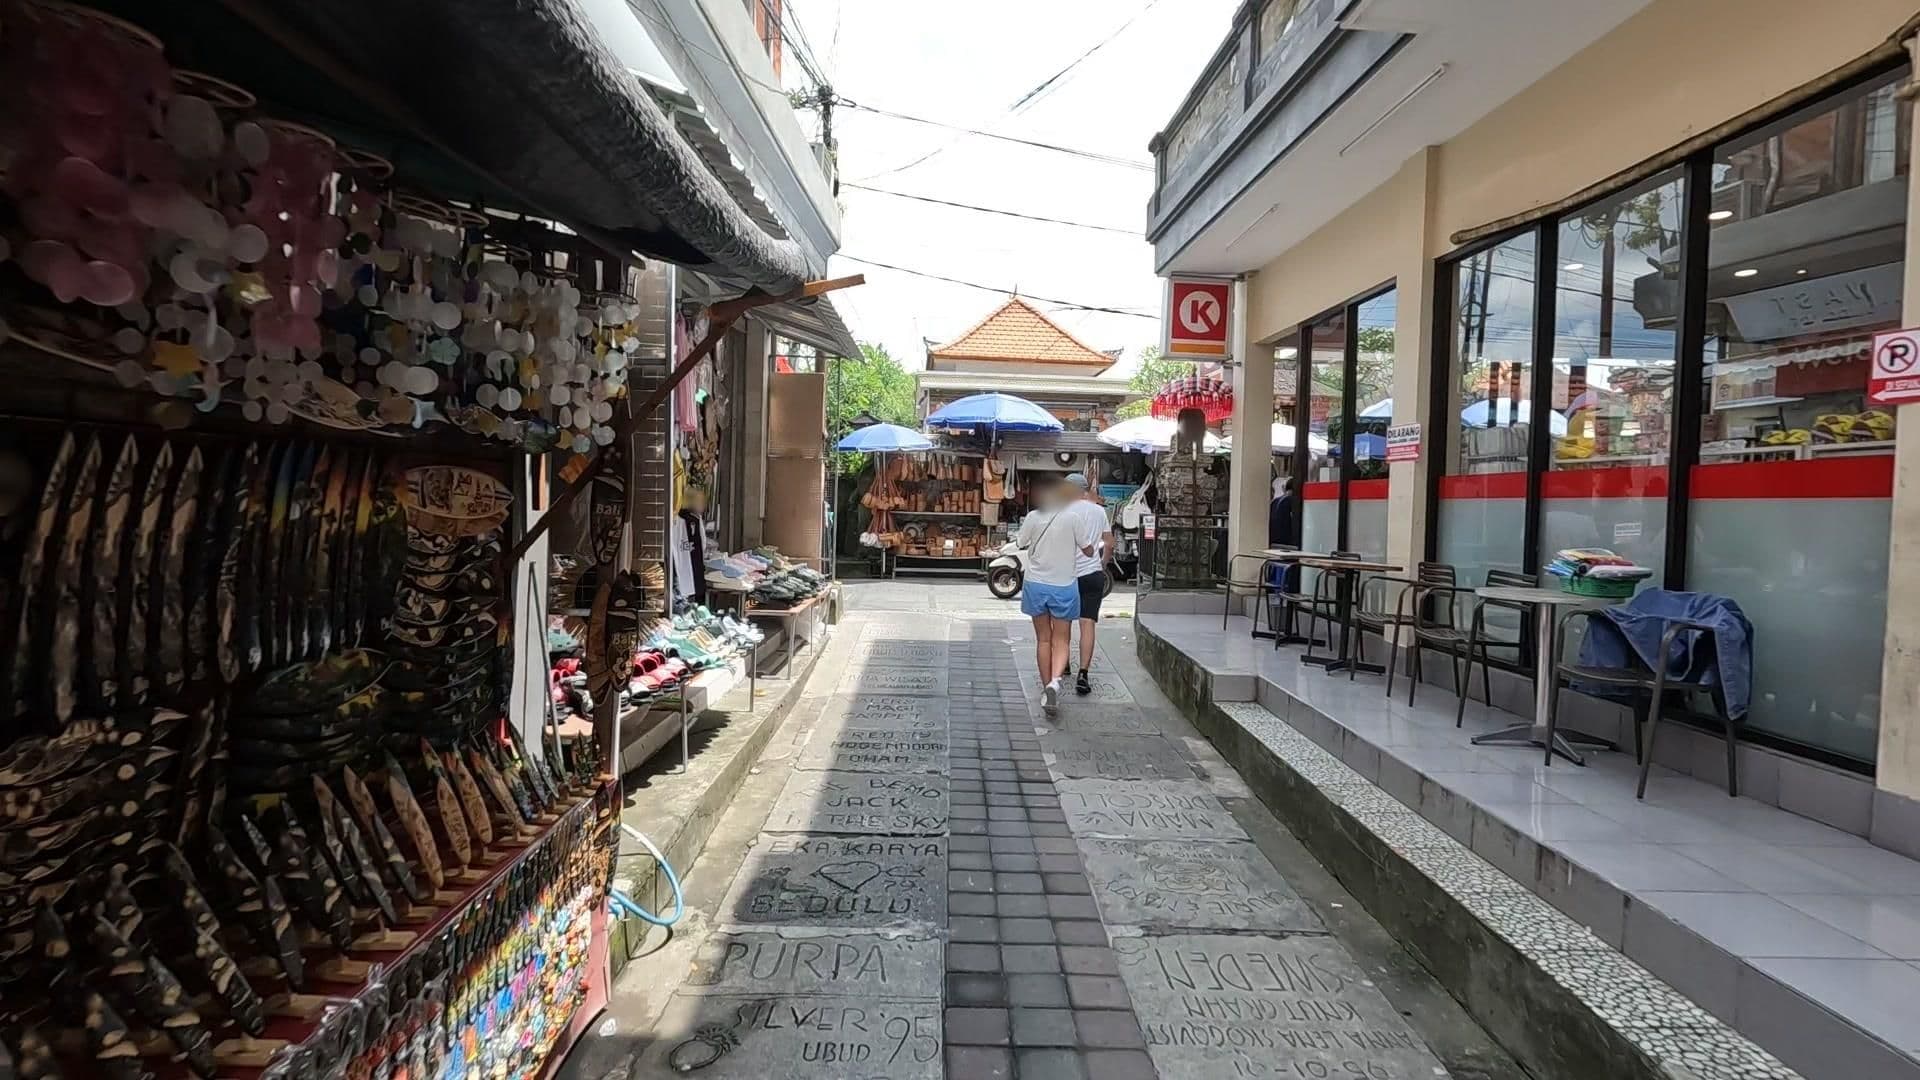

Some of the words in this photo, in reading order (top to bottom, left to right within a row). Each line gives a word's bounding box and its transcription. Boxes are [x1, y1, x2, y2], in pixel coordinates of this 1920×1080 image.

[826, 795, 909, 808] JACK
[892, 814, 948, 829] SKY
[1154, 947, 1354, 994] SWEDEN
[733, 1003, 869, 1033] SILVER
[801, 1041, 872, 1063] UBUD
